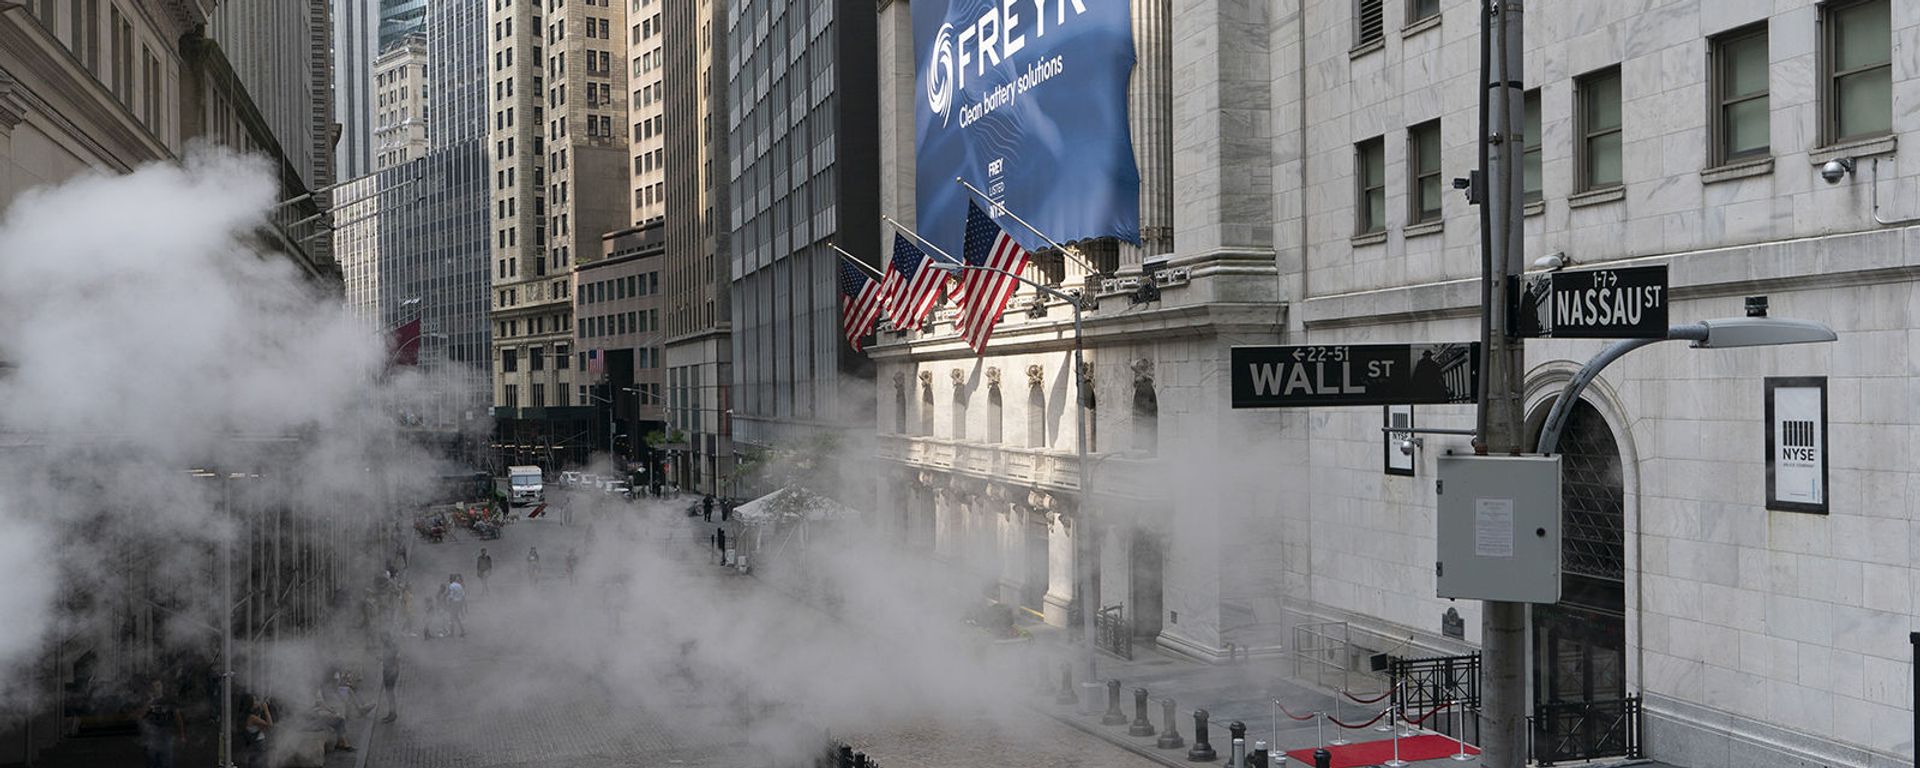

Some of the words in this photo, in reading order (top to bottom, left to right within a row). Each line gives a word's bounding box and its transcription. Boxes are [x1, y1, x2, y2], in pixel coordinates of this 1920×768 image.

[959, 102, 983, 129] Clean
[983, 80, 1017, 115] battery
[1017, 54, 1063, 94] solutions
[1593, 271, 1607, 288] 1-7
[1557, 287, 1643, 326] NASSAU
[1644, 285, 1662, 308] ST
[1307, 346, 1350, 362] 22-51
[1249, 361, 1367, 396] WALL
[1367, 360, 1395, 378] ST
[1782, 447, 1815, 461] NYSE
